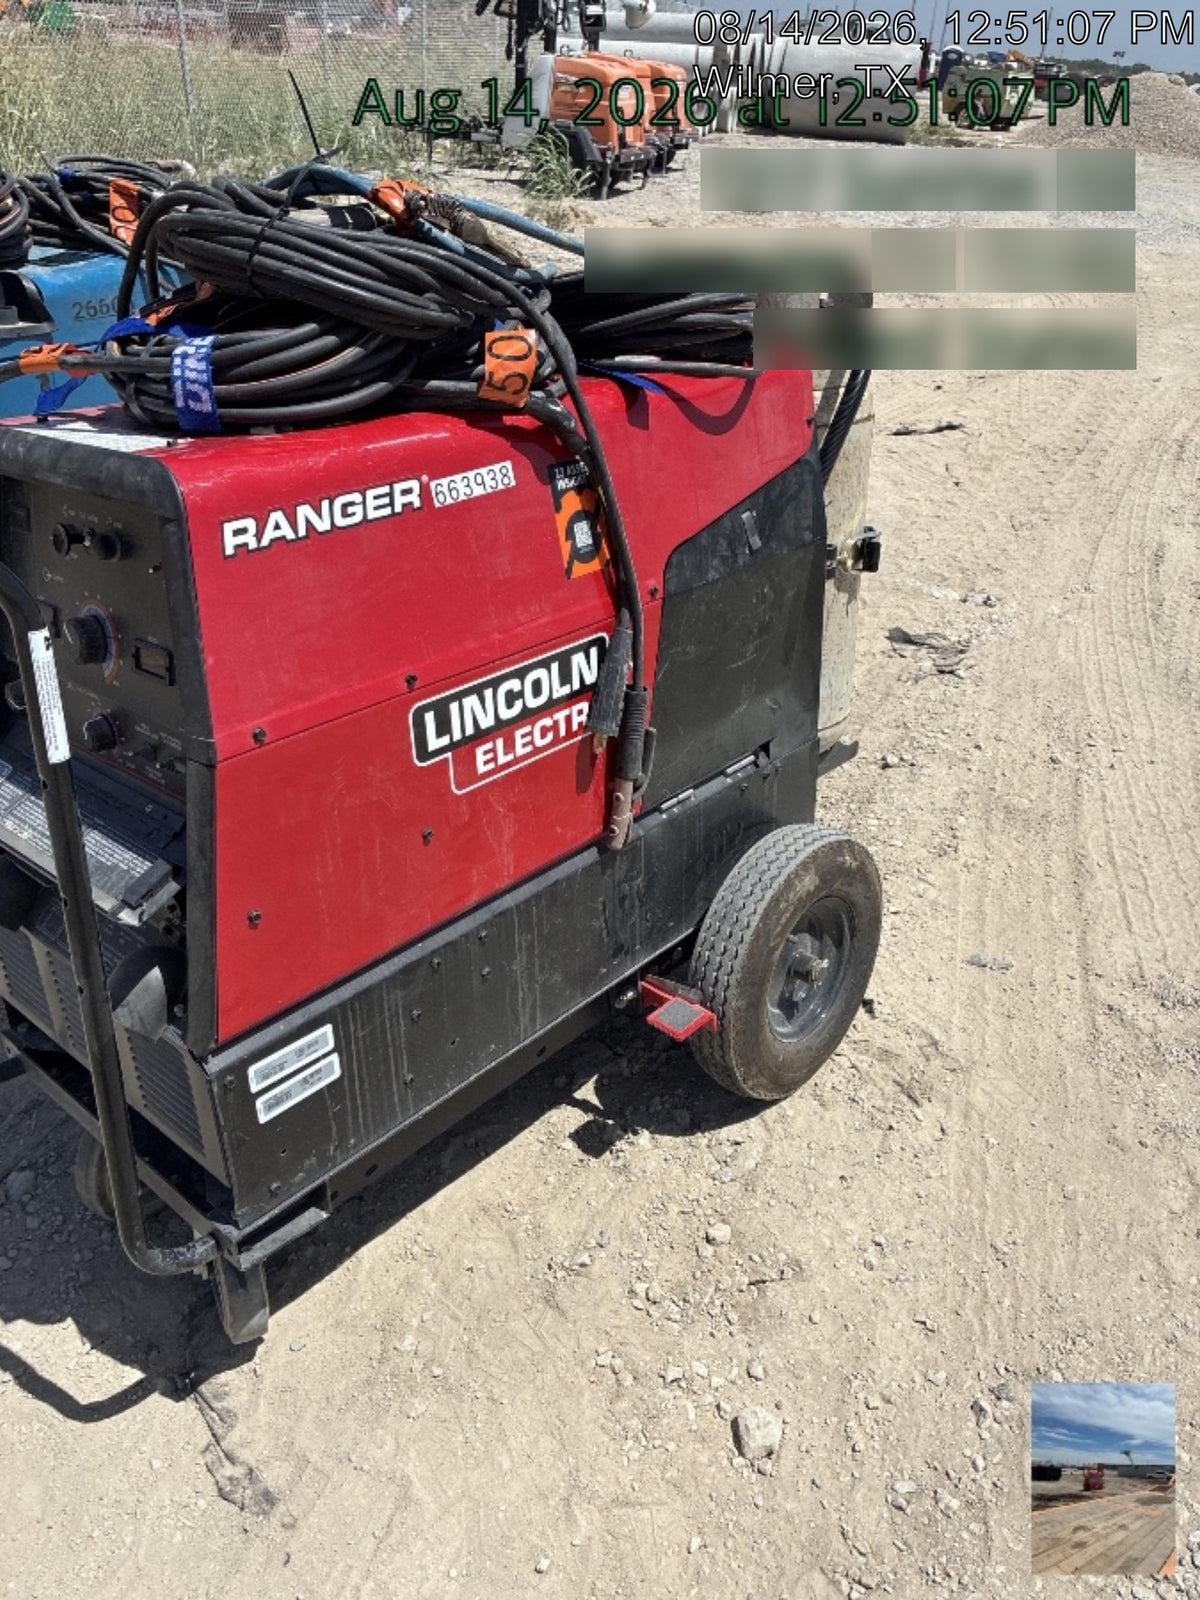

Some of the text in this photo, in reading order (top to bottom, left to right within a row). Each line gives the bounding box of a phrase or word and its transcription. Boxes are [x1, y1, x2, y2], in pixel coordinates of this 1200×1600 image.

[483, 333, 533, 397] 50
[221, 478, 423, 559] RANGER
[433, 464, 512, 505] 663938
[423, 645, 600, 753] LINCOLN
[475, 701, 590, 776] ELECTR
